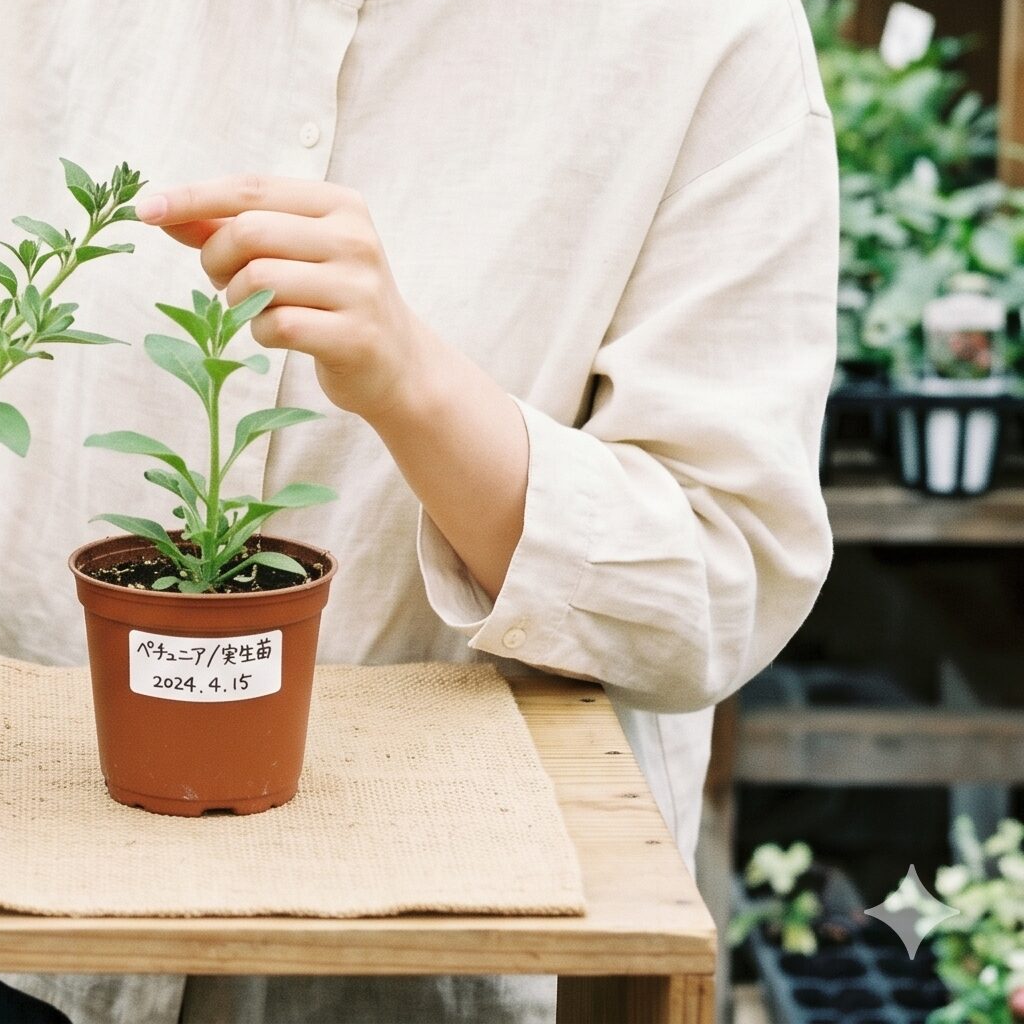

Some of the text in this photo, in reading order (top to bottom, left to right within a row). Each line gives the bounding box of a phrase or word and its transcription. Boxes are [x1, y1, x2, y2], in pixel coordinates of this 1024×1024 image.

[137, 638, 272, 668] ペチュニア/実生苗
